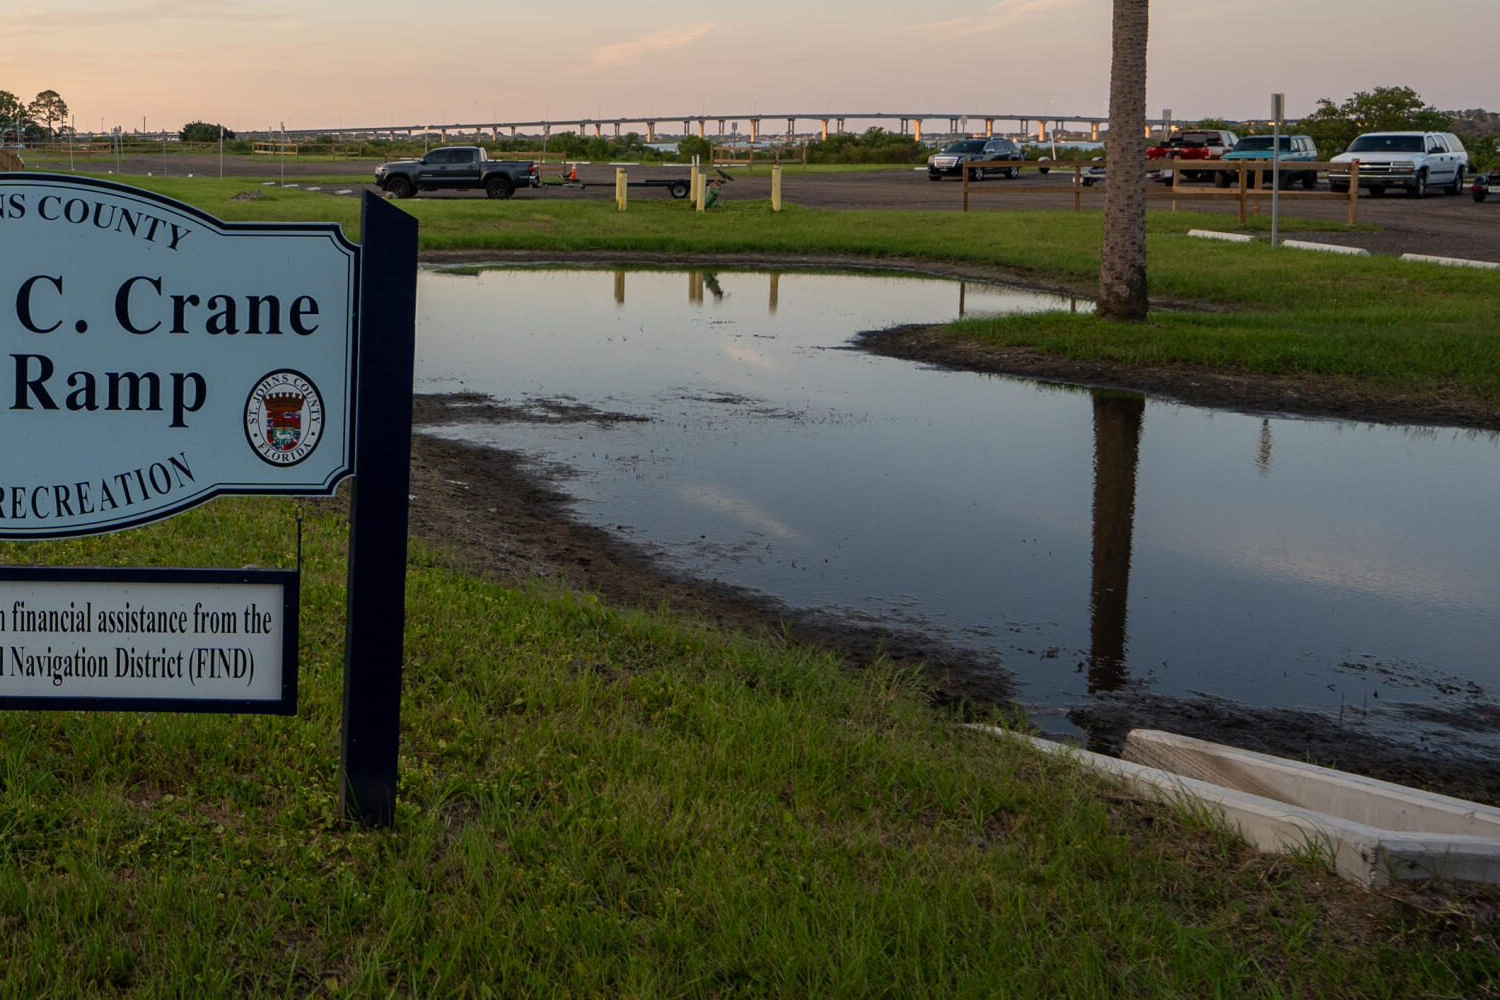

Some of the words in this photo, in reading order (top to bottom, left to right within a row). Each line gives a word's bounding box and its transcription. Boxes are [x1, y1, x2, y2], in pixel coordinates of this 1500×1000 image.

[38, 195, 191, 251] COUNTY
[15, 275, 88, 334] C.
[114, 276, 320, 336] Crane
[9, 353, 207, 428] Ramp
[253, 374, 289, 403] JOHNS
[293, 377, 321, 425] COUNTY
[249, 407, 258, 424] ST.
[257, 442, 312, 462] FLORIDA
[11, 602, 92, 633] financial
[97, 603, 187, 634] assistance
[193, 602, 237, 634] from
[243, 603, 272, 635] the
[10, 646, 108, 686] Navigation
[114, 647, 183, 679] District
[188, 648, 255, 686] (FIND)
